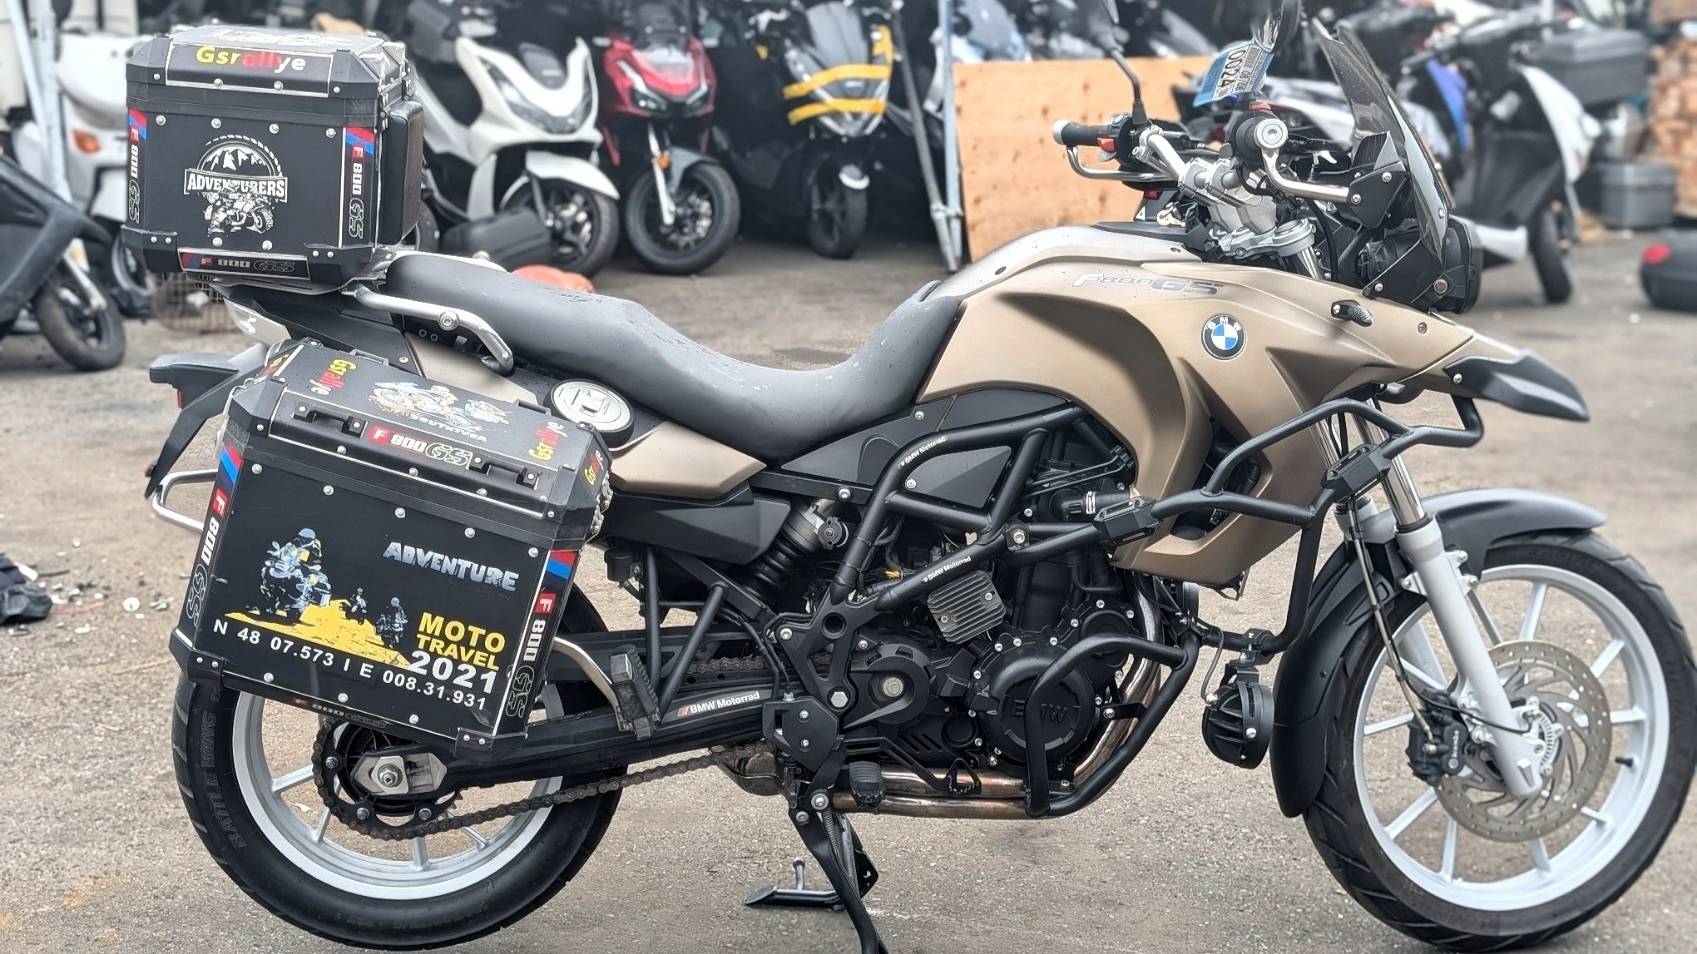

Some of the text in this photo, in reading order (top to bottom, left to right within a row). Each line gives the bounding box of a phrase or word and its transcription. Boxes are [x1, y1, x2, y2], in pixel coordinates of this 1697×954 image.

[196, 44, 306, 74] Gsrallye
[130, 144, 139, 178] 800
[128, 180, 140, 224] GS
[187, 173, 285, 198] ADVENTURERS
[349, 146, 365, 239] F 800 GS
[217, 259, 251, 268] 800
[373, 429, 474, 469] F 800 GS
[185, 495, 226, 627] F 800 GS
[382, 541, 519, 592] ADVENTURE
[416, 633, 500, 671] TRAVEL
[418, 612, 506, 653] MOTO
[213, 619, 229, 635] N
[237, 627, 261, 645] 48
[270, 636, 335, 667] 07.573
[359, 662, 374, 679] E
[382, 670, 487, 711] 008.31.931
[408, 650, 497, 694] 2021
[505, 598, 553, 718] F 800 GS
[689, 690, 760, 714] BMW Motorrad
